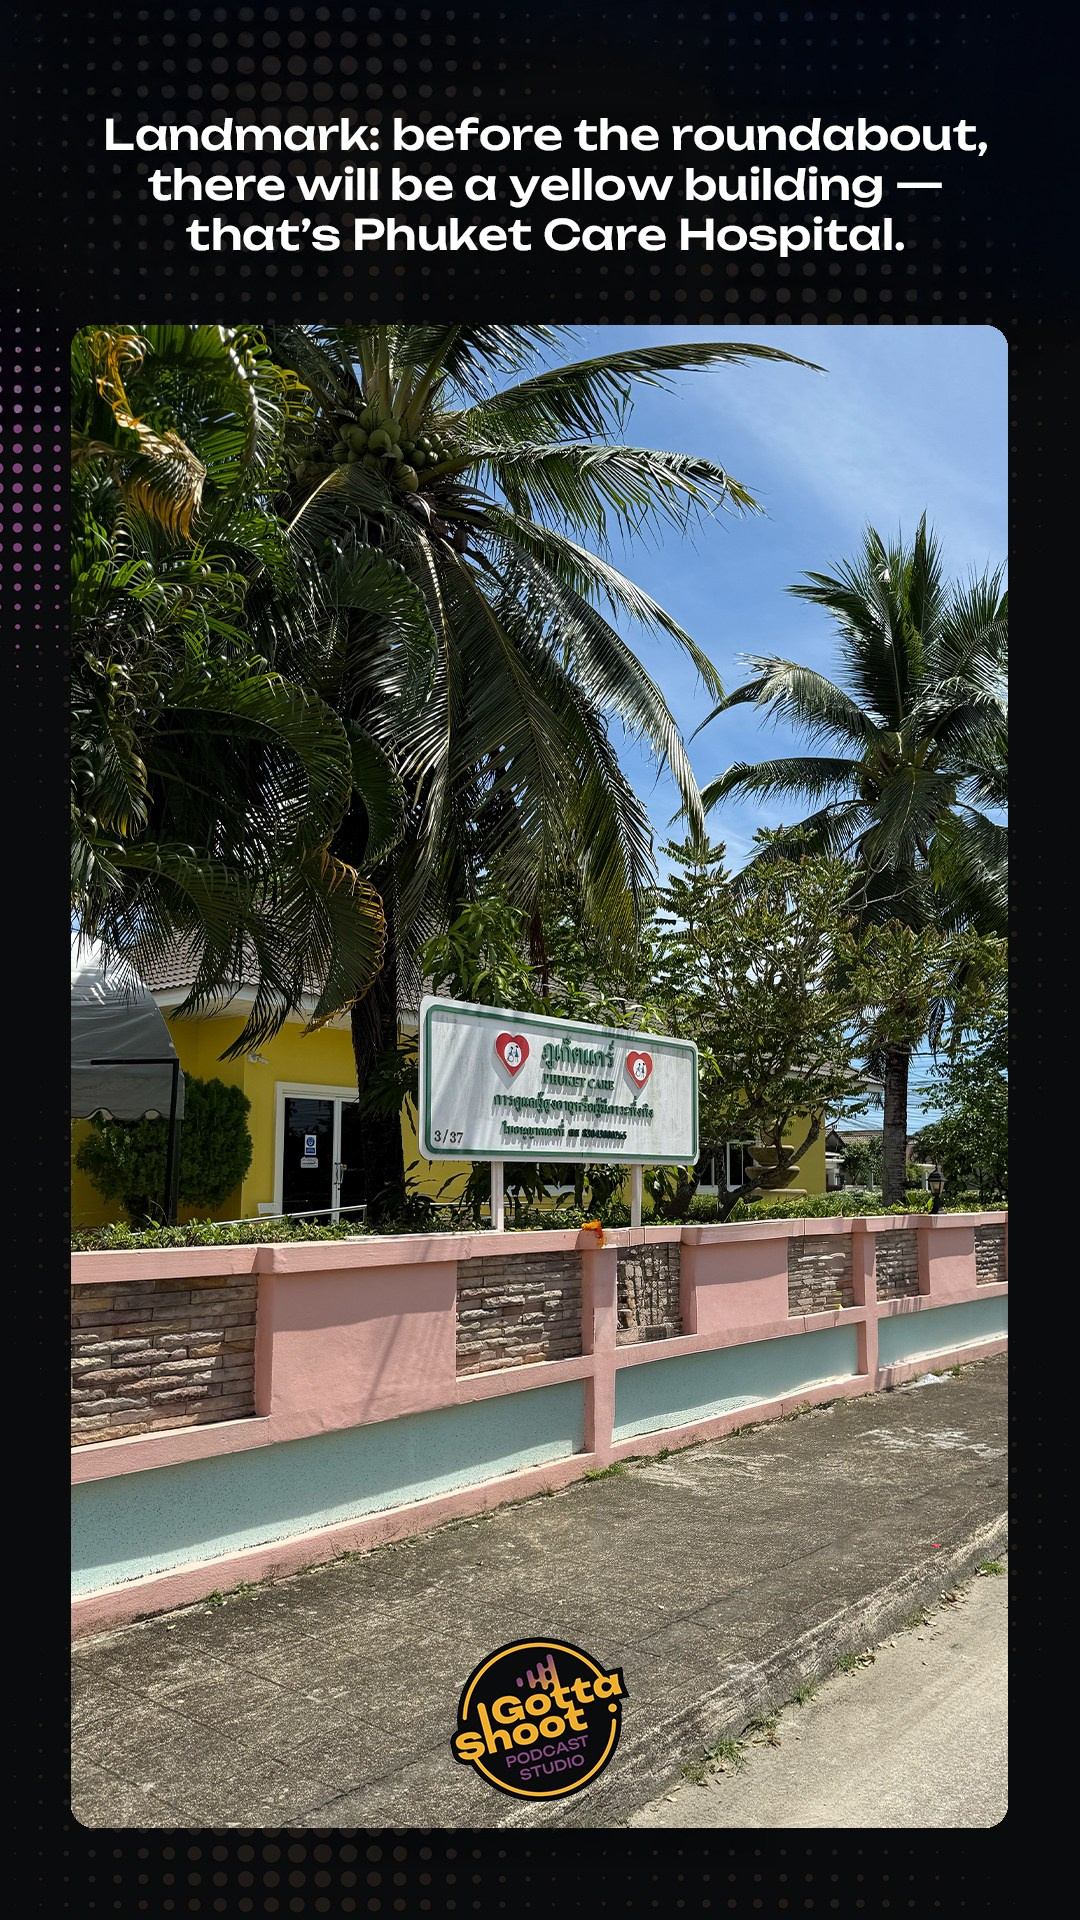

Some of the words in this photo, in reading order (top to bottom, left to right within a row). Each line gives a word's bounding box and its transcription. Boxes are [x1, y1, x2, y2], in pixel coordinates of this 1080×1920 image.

[543, 1073, 586, 1088] PHUKET
[587, 1078, 615, 1091] CARE
[434, 1129, 464, 1144] 3/37
